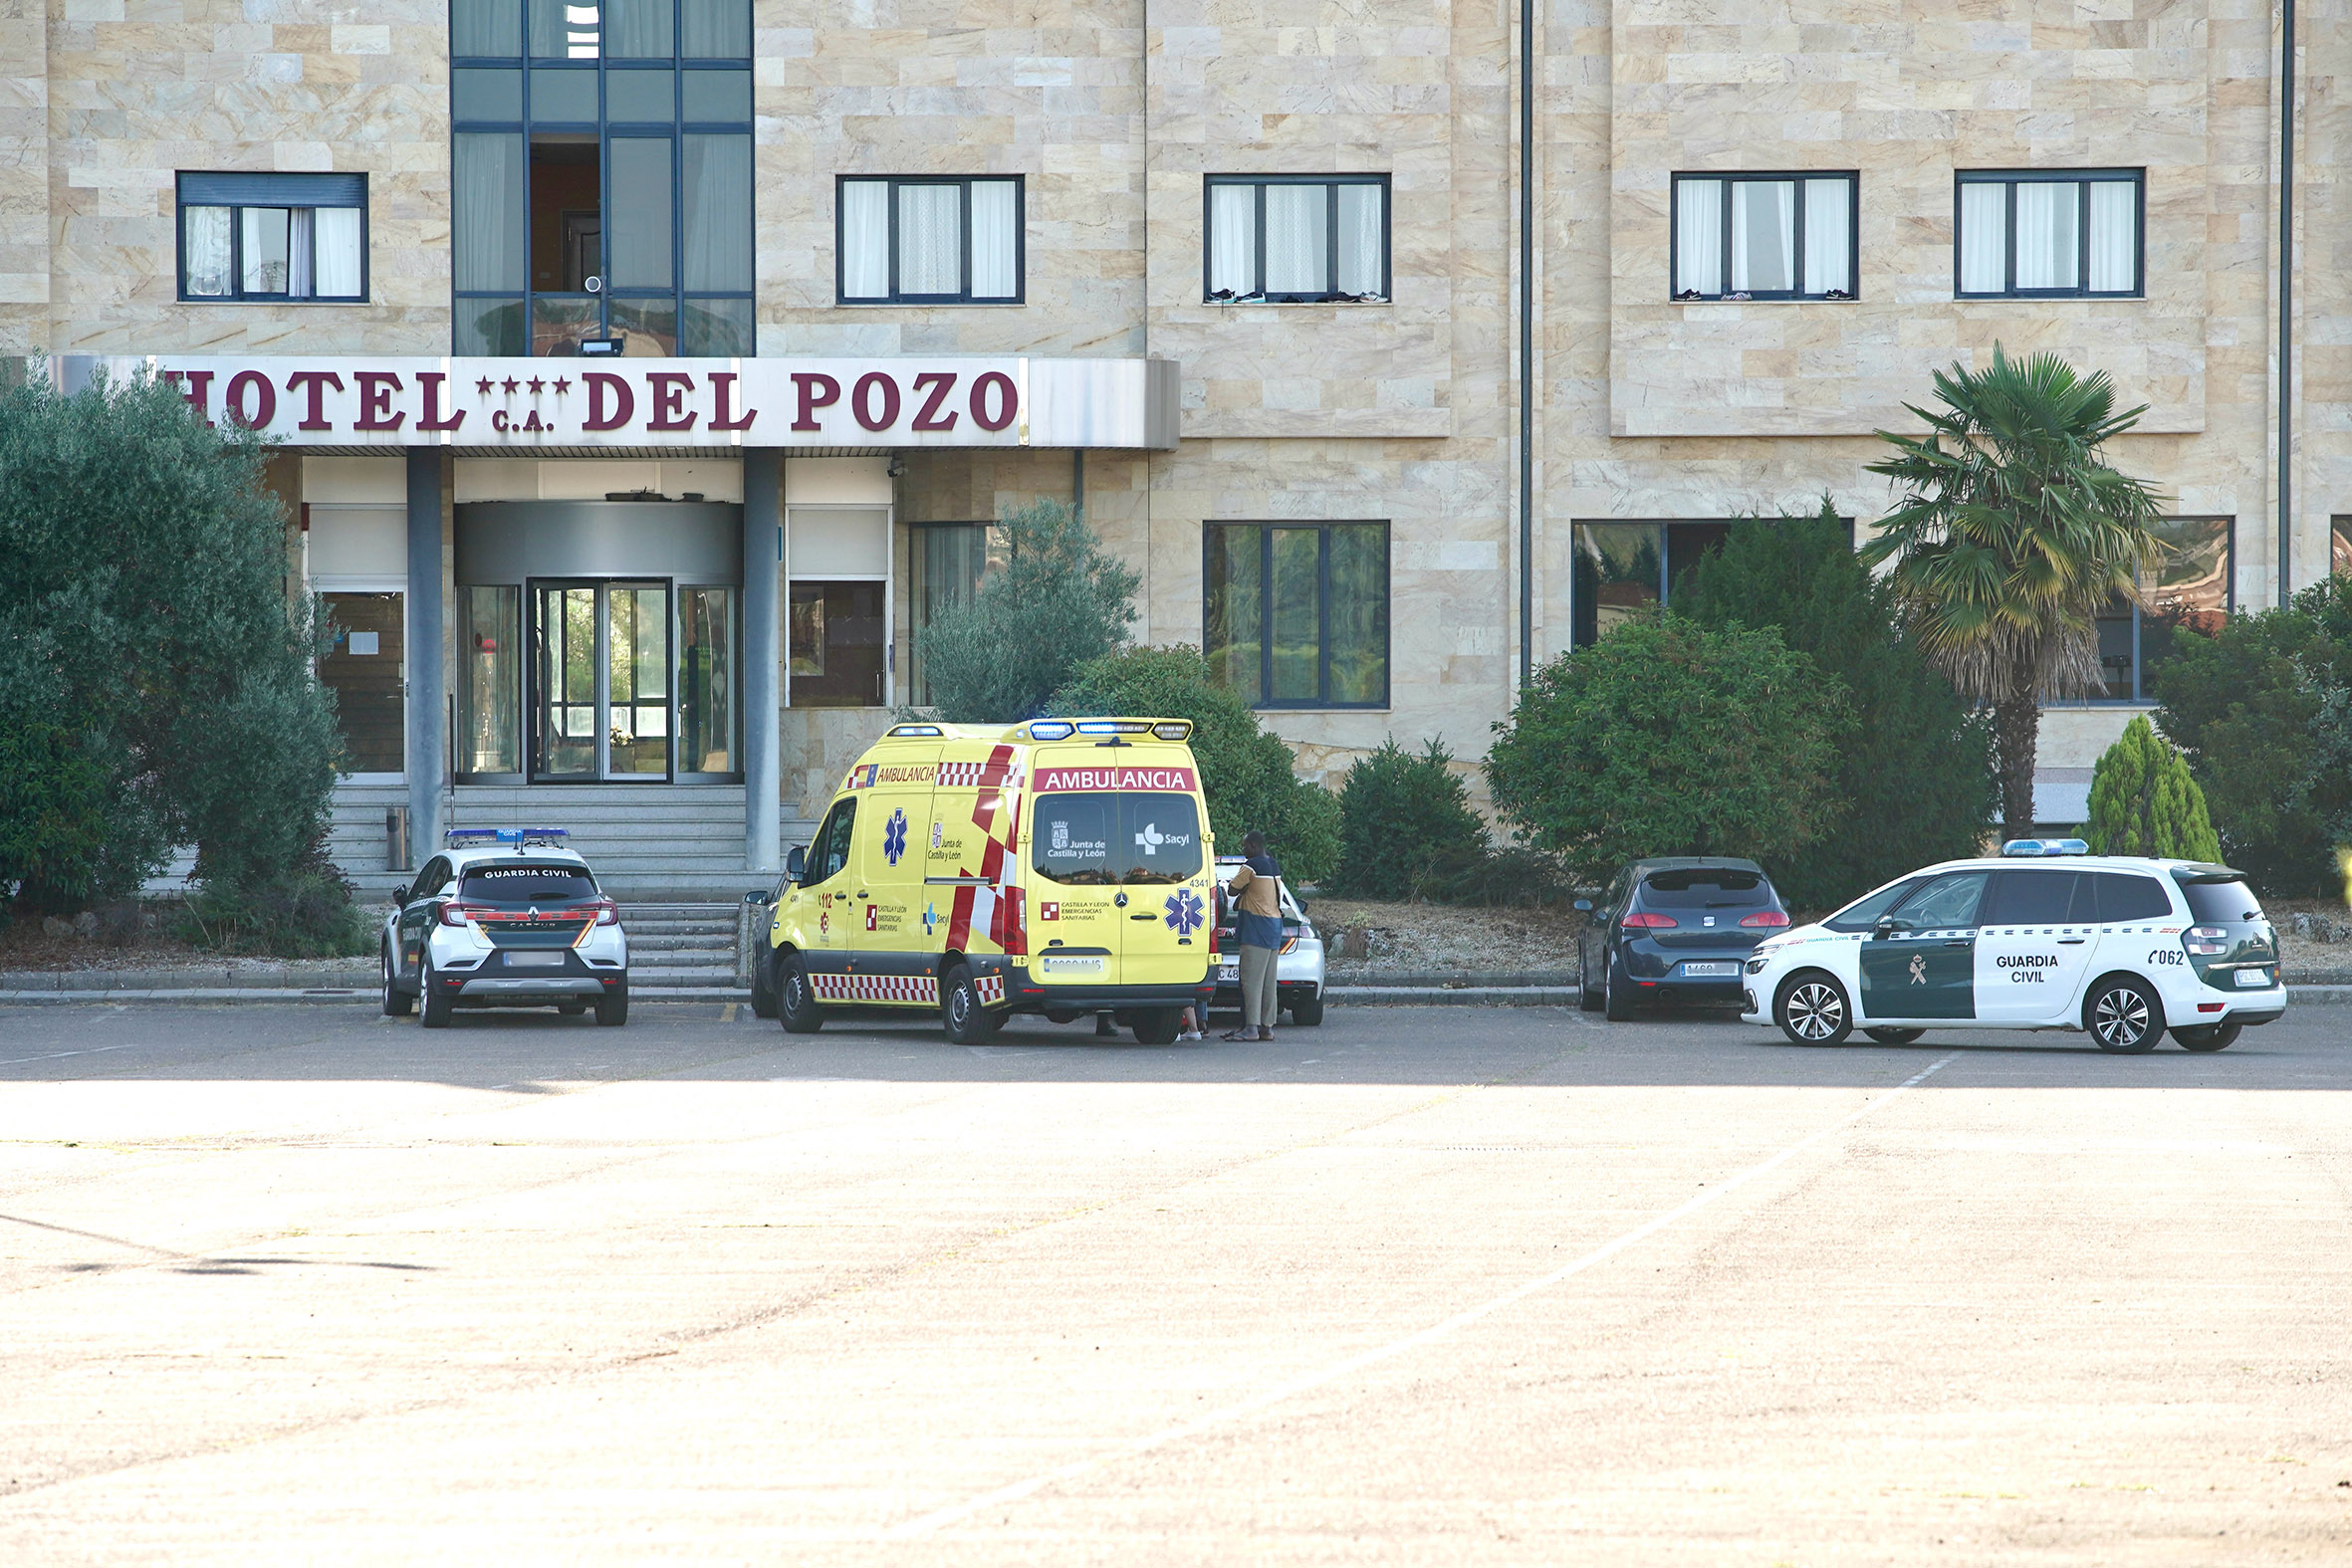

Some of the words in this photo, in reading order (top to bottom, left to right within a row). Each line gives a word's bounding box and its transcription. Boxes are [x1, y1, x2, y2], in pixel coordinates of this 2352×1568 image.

[163, 369, 467, 431] HOTEL
[581, 371, 759, 431] DEL
[790, 370, 1020, 432] POZO
[492, 409, 555, 432] C.A.
[876, 766, 935, 783] AMBULANCIA
[1045, 771, 1187, 789] AMBULANCIA
[1165, 833, 1190, 845] Sacyl
[1048, 849, 1076, 858] Castilla
[1085, 849, 1105, 858] León
[485, 869, 540, 879] GUARDIA
[542, 869, 573, 879] CIVIL
[1189, 878, 1209, 888] 4341
[822, 892, 832, 909] 112
[936, 913, 950, 927] Sacyl
[1996, 955, 2059, 969] GUARDIA
[2158, 950, 2184, 967] 062
[2010, 971, 2045, 984] CIVIL
